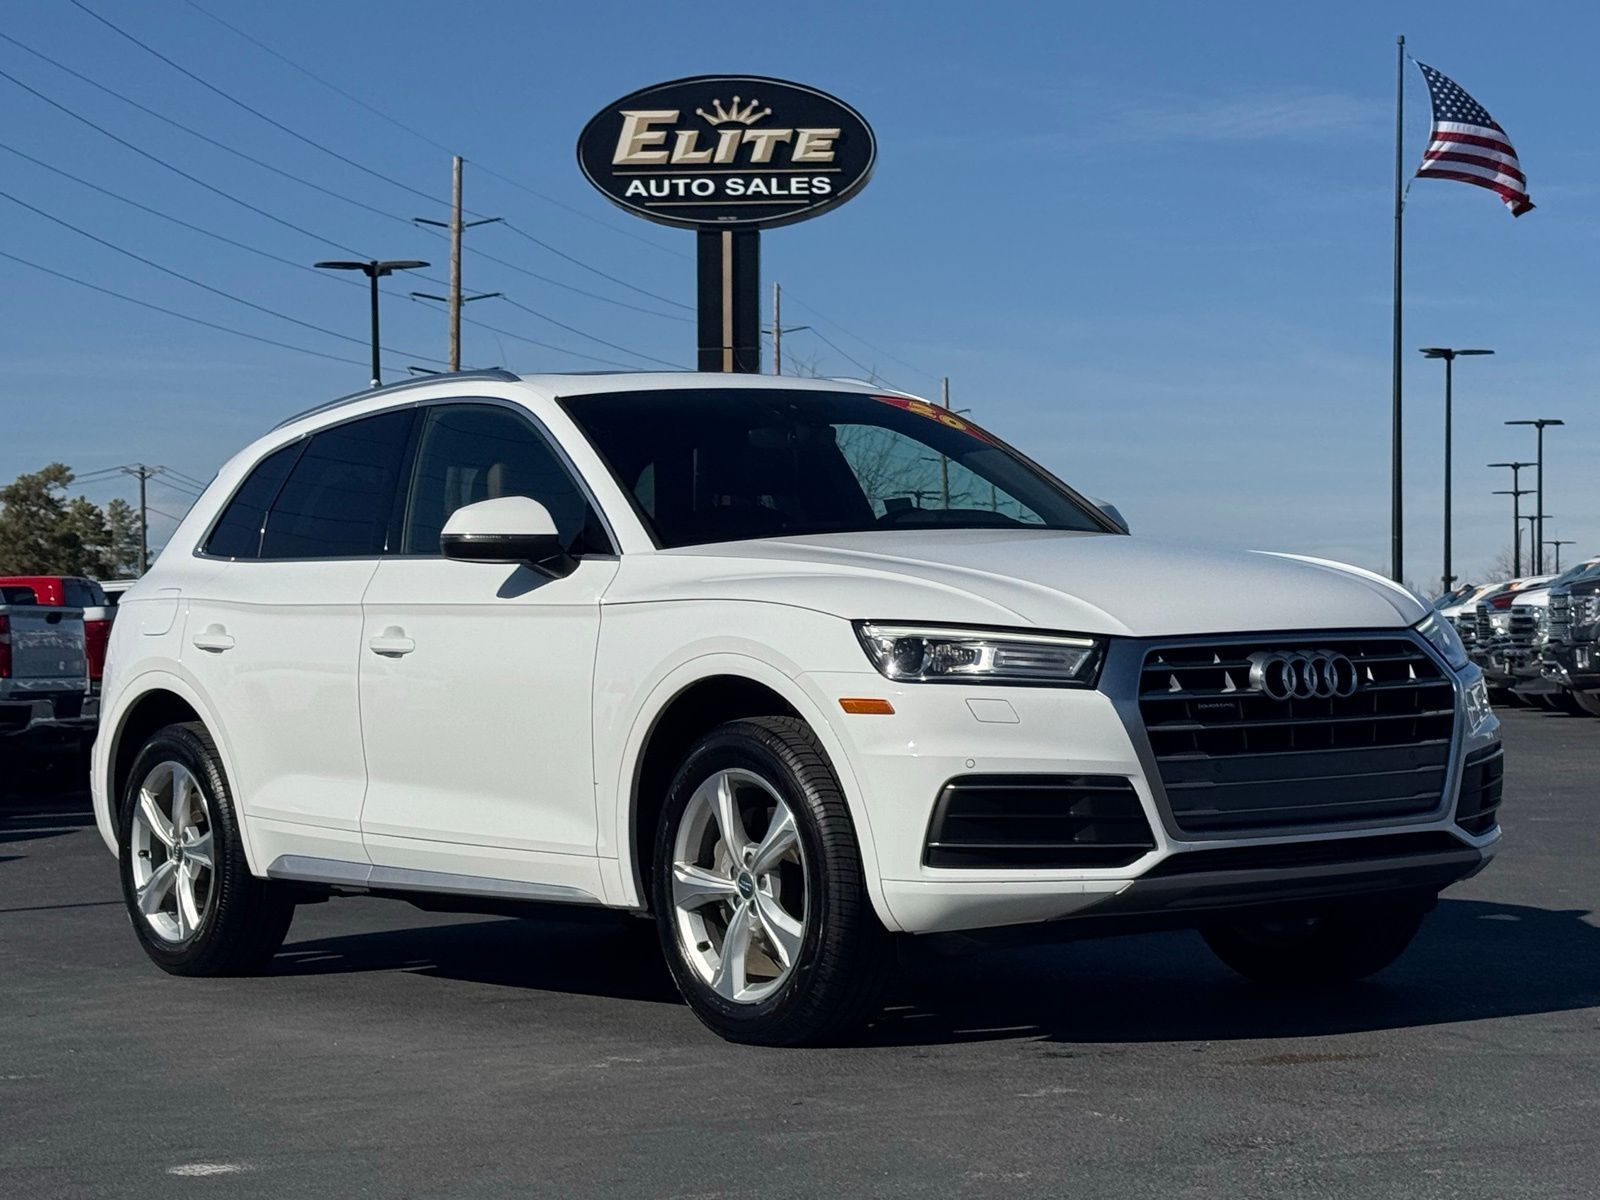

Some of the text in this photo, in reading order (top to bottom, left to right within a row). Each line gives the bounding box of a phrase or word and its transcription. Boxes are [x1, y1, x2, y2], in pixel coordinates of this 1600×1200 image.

[612, 110, 841, 164] ELITE
[625, 177, 832, 197] AUTO SALES
